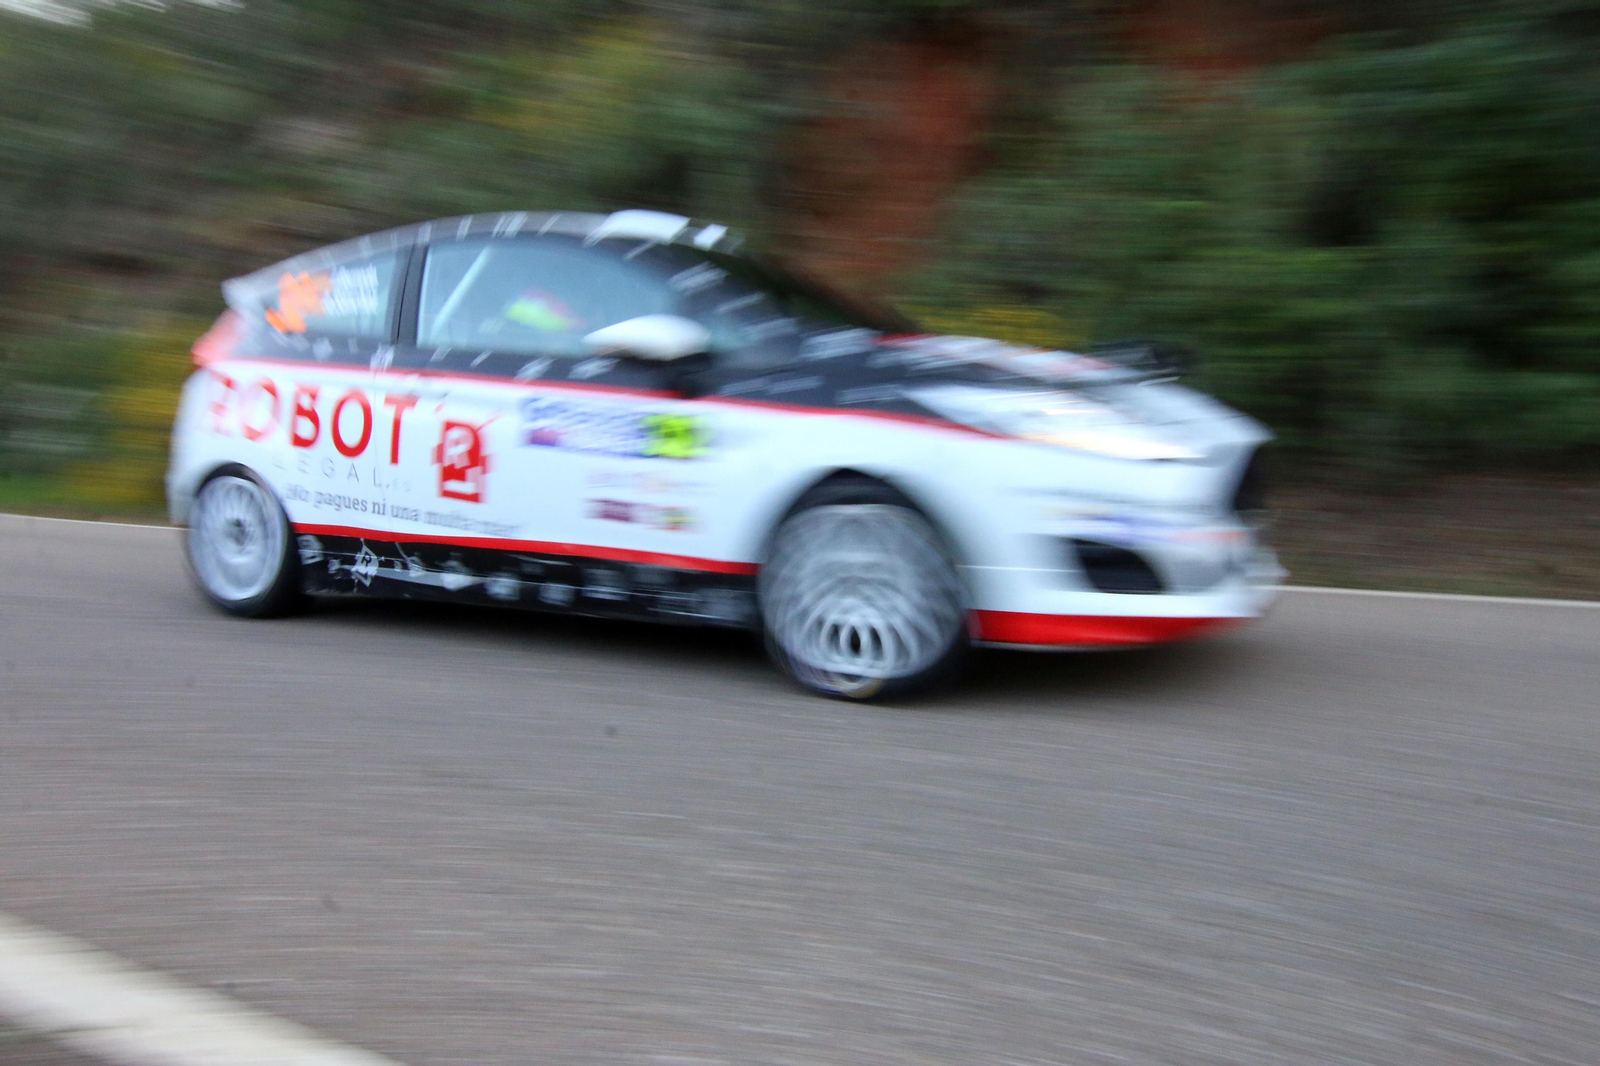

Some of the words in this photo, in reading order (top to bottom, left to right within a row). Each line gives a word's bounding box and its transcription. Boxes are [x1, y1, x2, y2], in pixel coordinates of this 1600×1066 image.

[314, 490, 368, 512] pagues
[371, 498, 386, 515] ni
[390, 504, 419, 522] una
